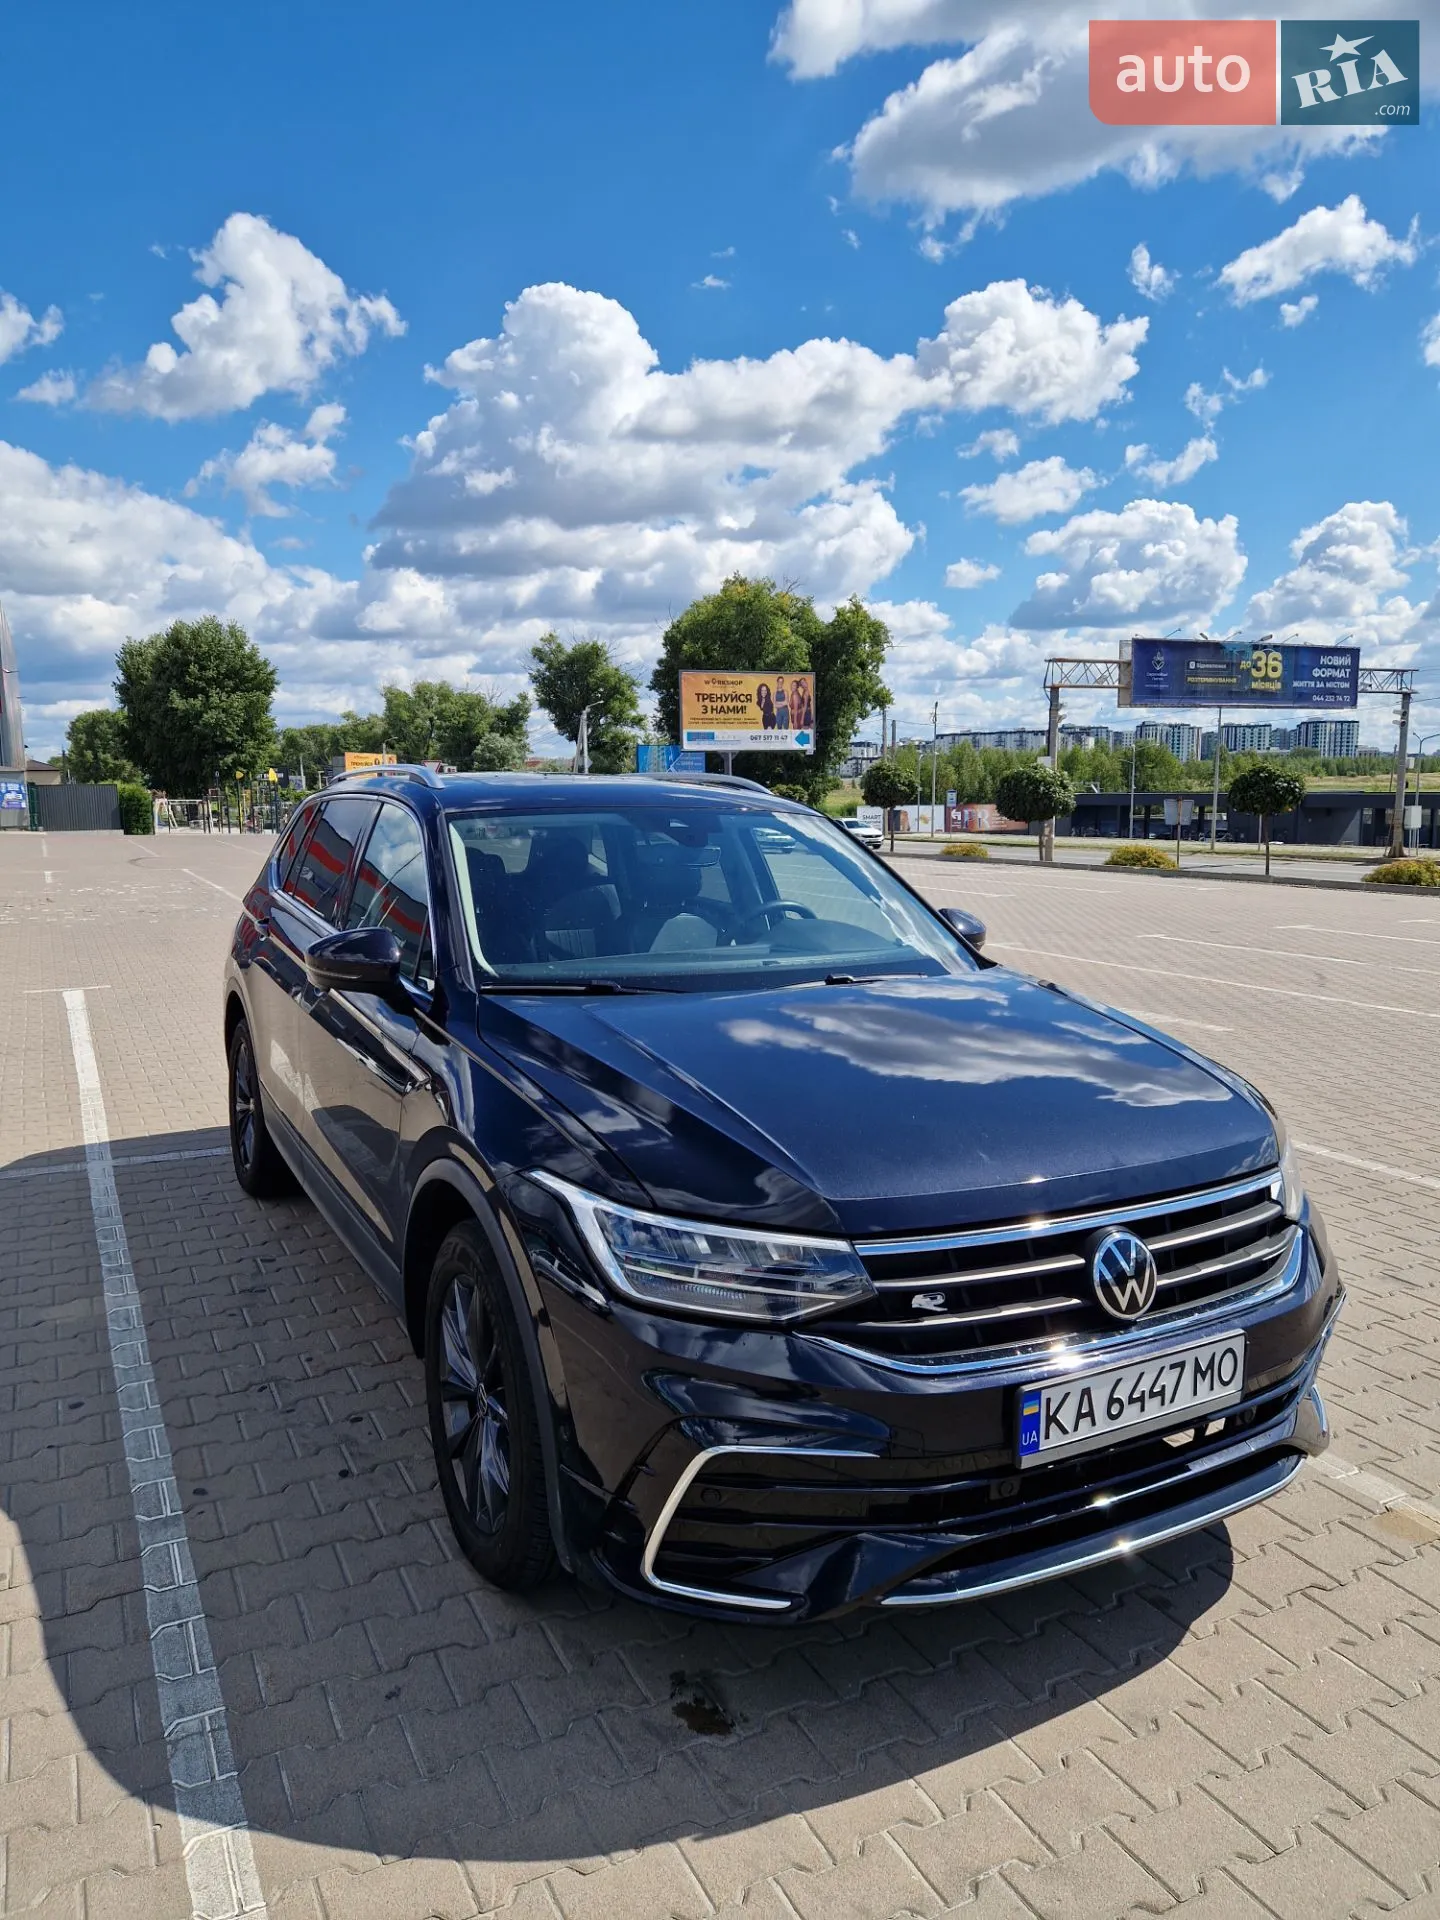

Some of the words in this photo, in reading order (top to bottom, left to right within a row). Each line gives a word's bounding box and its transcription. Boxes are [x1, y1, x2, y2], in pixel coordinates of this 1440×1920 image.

[1251, 650, 1283, 678] 36
[1320, 654, 1351, 666] НОВИЙ
[1312, 667, 1351, 678] ФОРМАТ
[1316, 680, 1325, 688] ЗА
[695, 691, 752, 703] ТРЕНУЙСЯ
[701, 705, 708, 714] З
[711, 705, 747, 714] НАМИ!
[1022, 1429, 1038, 1446] UA
